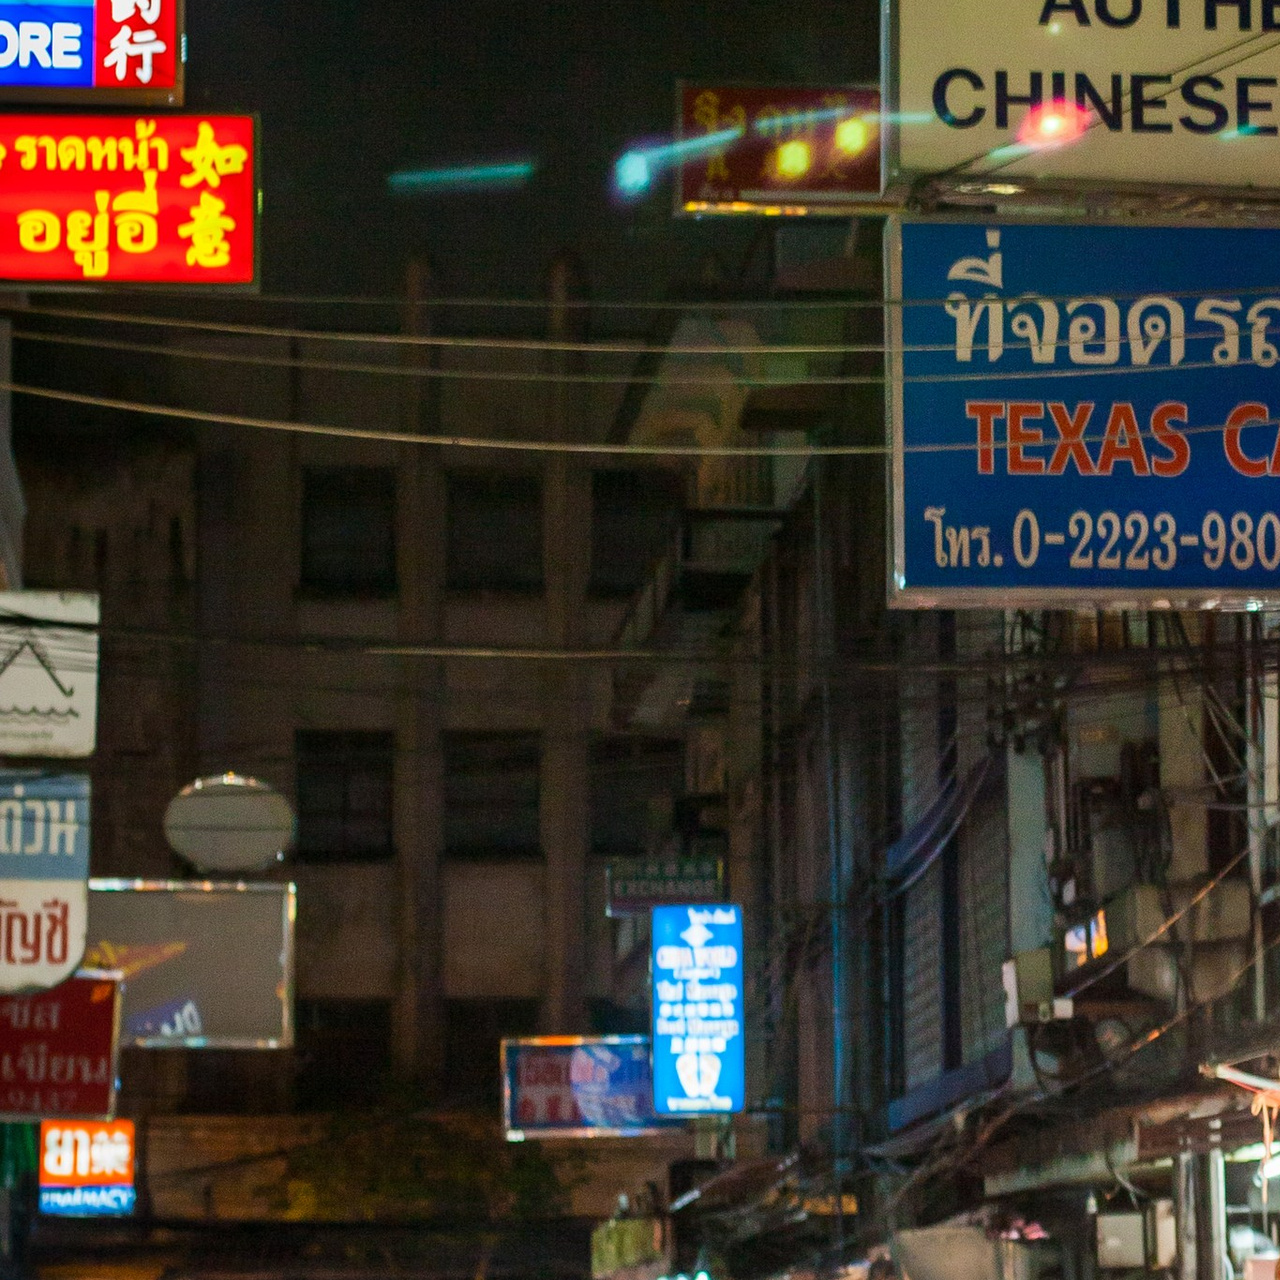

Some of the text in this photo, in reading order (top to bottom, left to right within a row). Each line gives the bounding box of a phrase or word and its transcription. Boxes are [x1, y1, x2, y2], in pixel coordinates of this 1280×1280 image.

[931, 67, 1280, 137] CHINESE
[15, 119, 169, 172] ราดหน้า
[966, 399, 1191, 478] TEXAS
[924, 506, 1003, 568] โทร.
